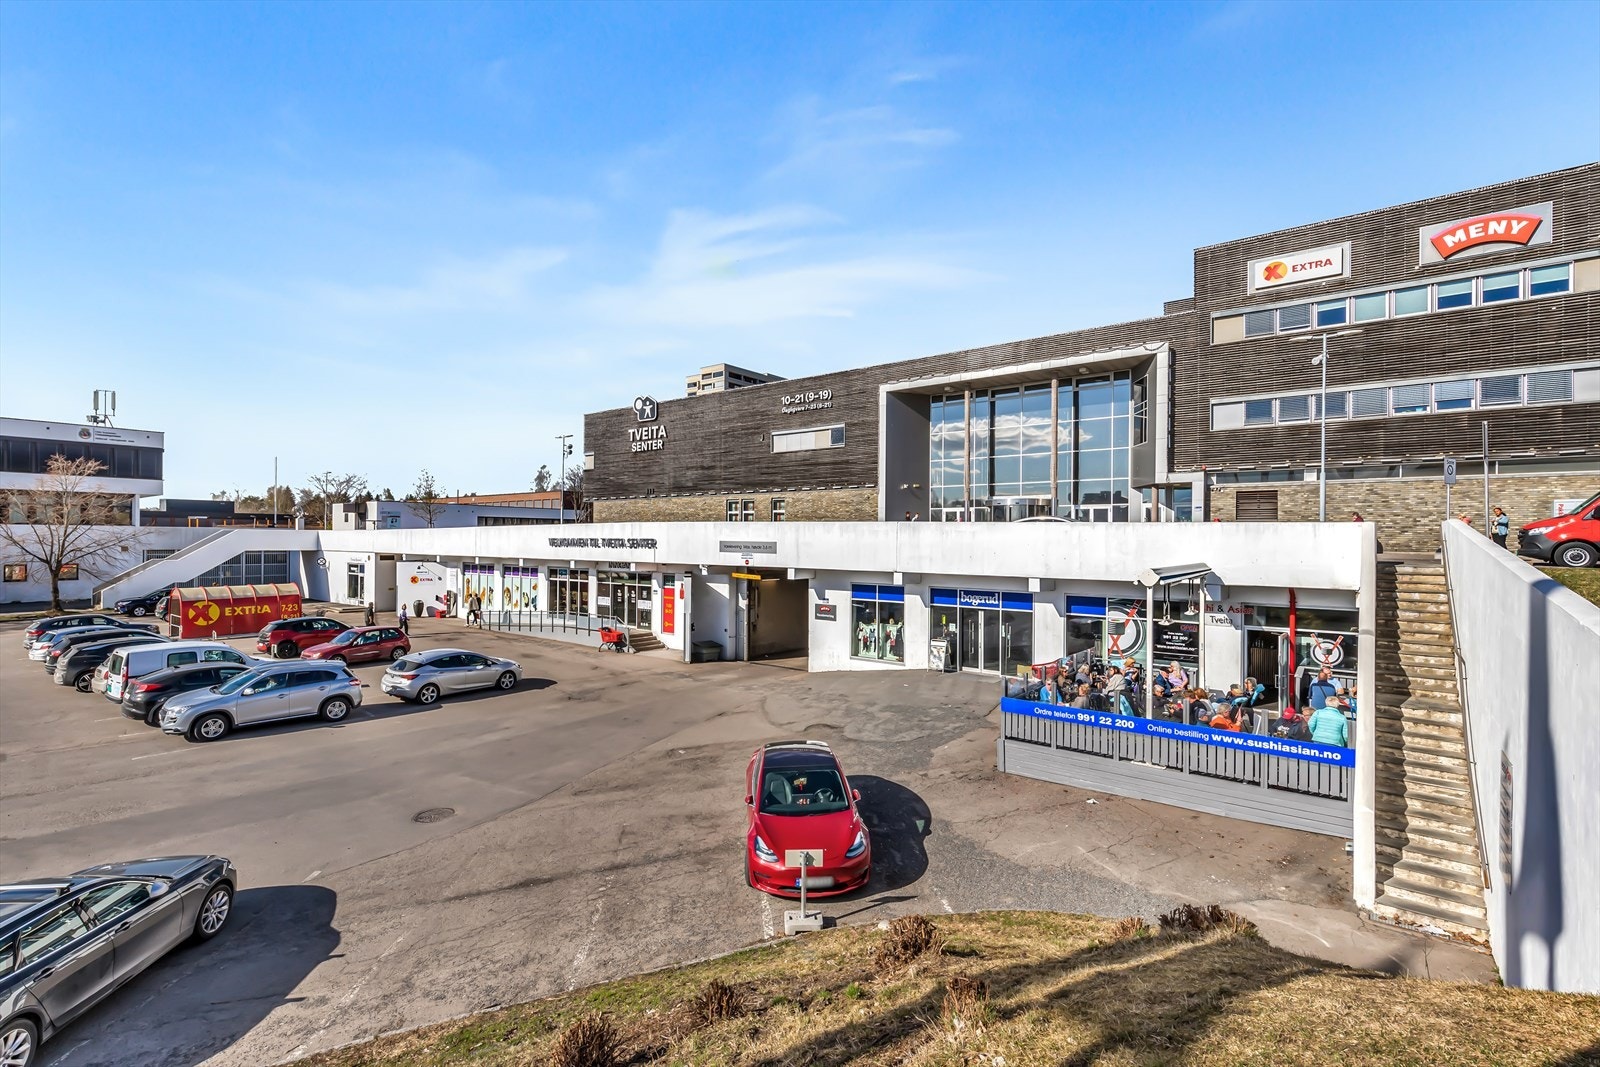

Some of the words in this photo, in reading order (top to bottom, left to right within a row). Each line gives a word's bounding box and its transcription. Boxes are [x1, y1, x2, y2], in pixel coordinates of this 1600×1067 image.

[1443, 220, 1529, 248] MENY
[1292, 258, 1333, 273] EXTRA
[805, 390, 832, 402] (9-19)
[628, 425, 667, 441] TVEITA
[631, 440, 663, 452] SENTER
[627, 538, 657, 549] SENTER
[961, 591, 998, 605] bogerud
[225, 604, 271, 616] EXTRA
[281, 604, 298, 612] 7-23
[1217, 604, 1224, 613] &
[1210, 615, 1232, 624] Tveita
[1034, 707, 1053, 716] Ordre
[1053, 710, 1076, 719] telefon
[1077, 713, 1095, 723] 991
[1099, 716, 1113, 725] 22
[1115, 719, 1135, 729] 200
[1147, 724, 1172, 734] Online
[1174, 728, 1209, 741] bestilling
[1211, 732, 1342, 760] www.sushiasian.no
